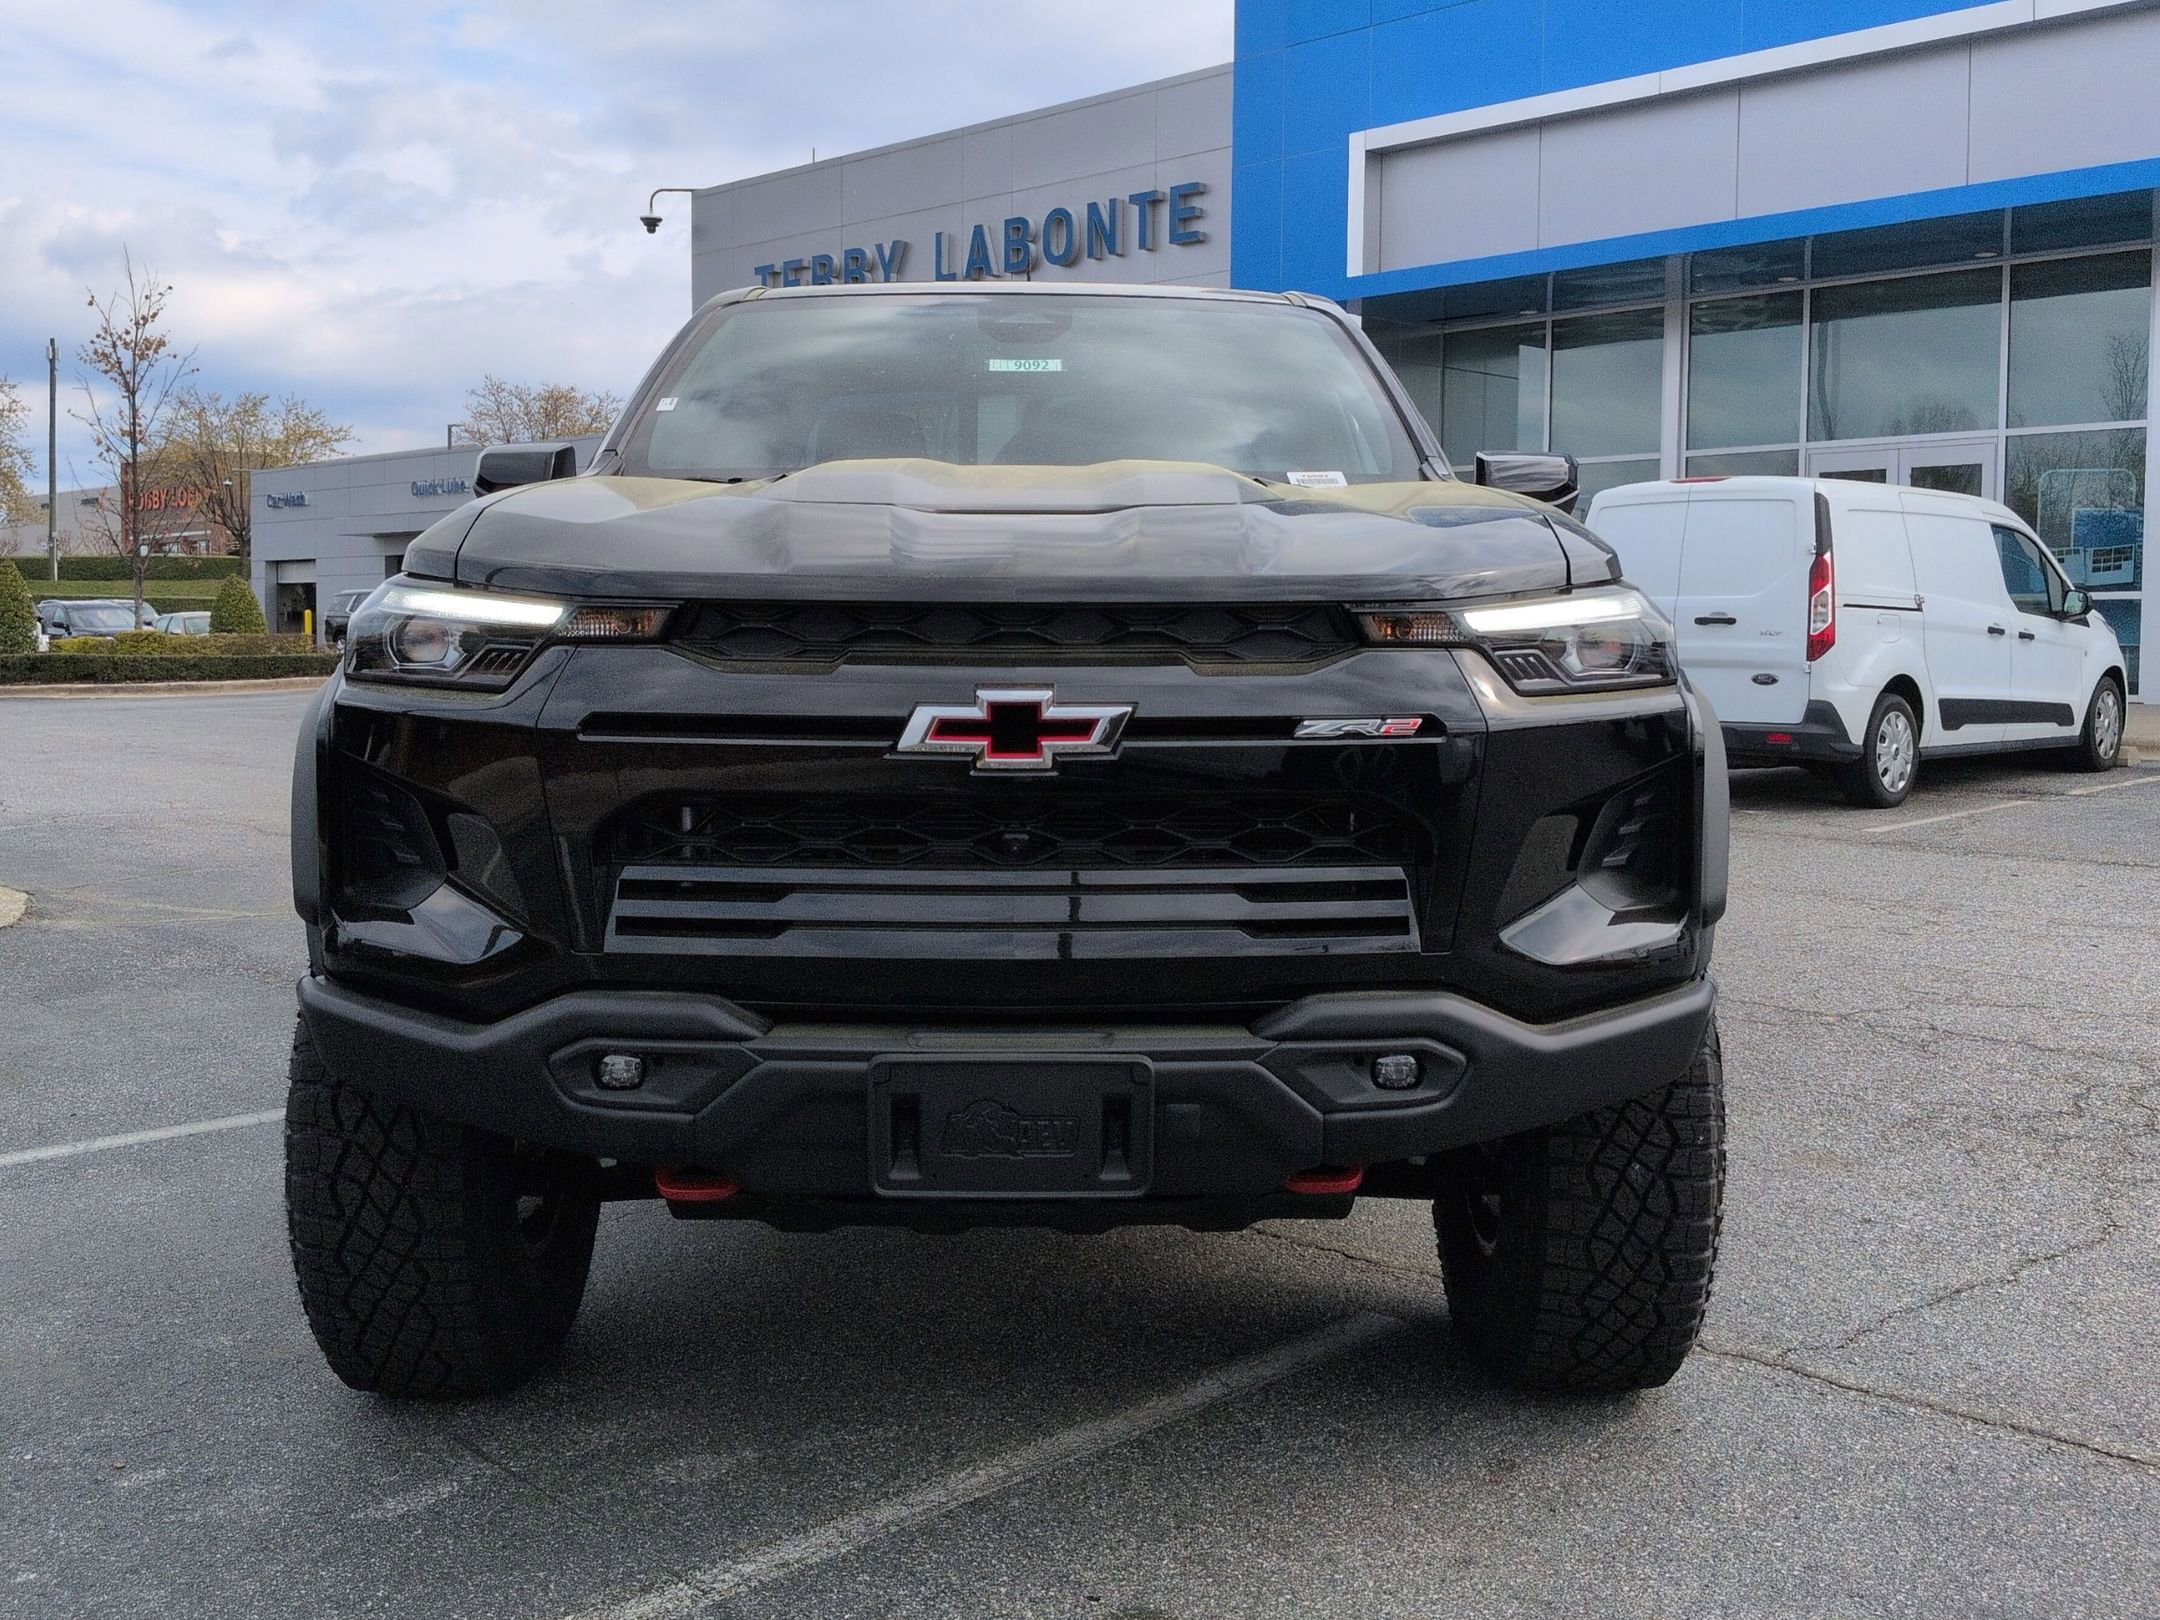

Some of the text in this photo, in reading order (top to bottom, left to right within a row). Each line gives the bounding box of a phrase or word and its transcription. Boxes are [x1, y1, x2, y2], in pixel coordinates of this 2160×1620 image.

[935, 181, 1206, 282] LABONTE
[1014, 360, 1049, 370] 9092
[411, 477, 465, 496] Quick Lube
[267, 491, 305, 509] Car Wash
[1294, 718, 1422, 738] ZR2
